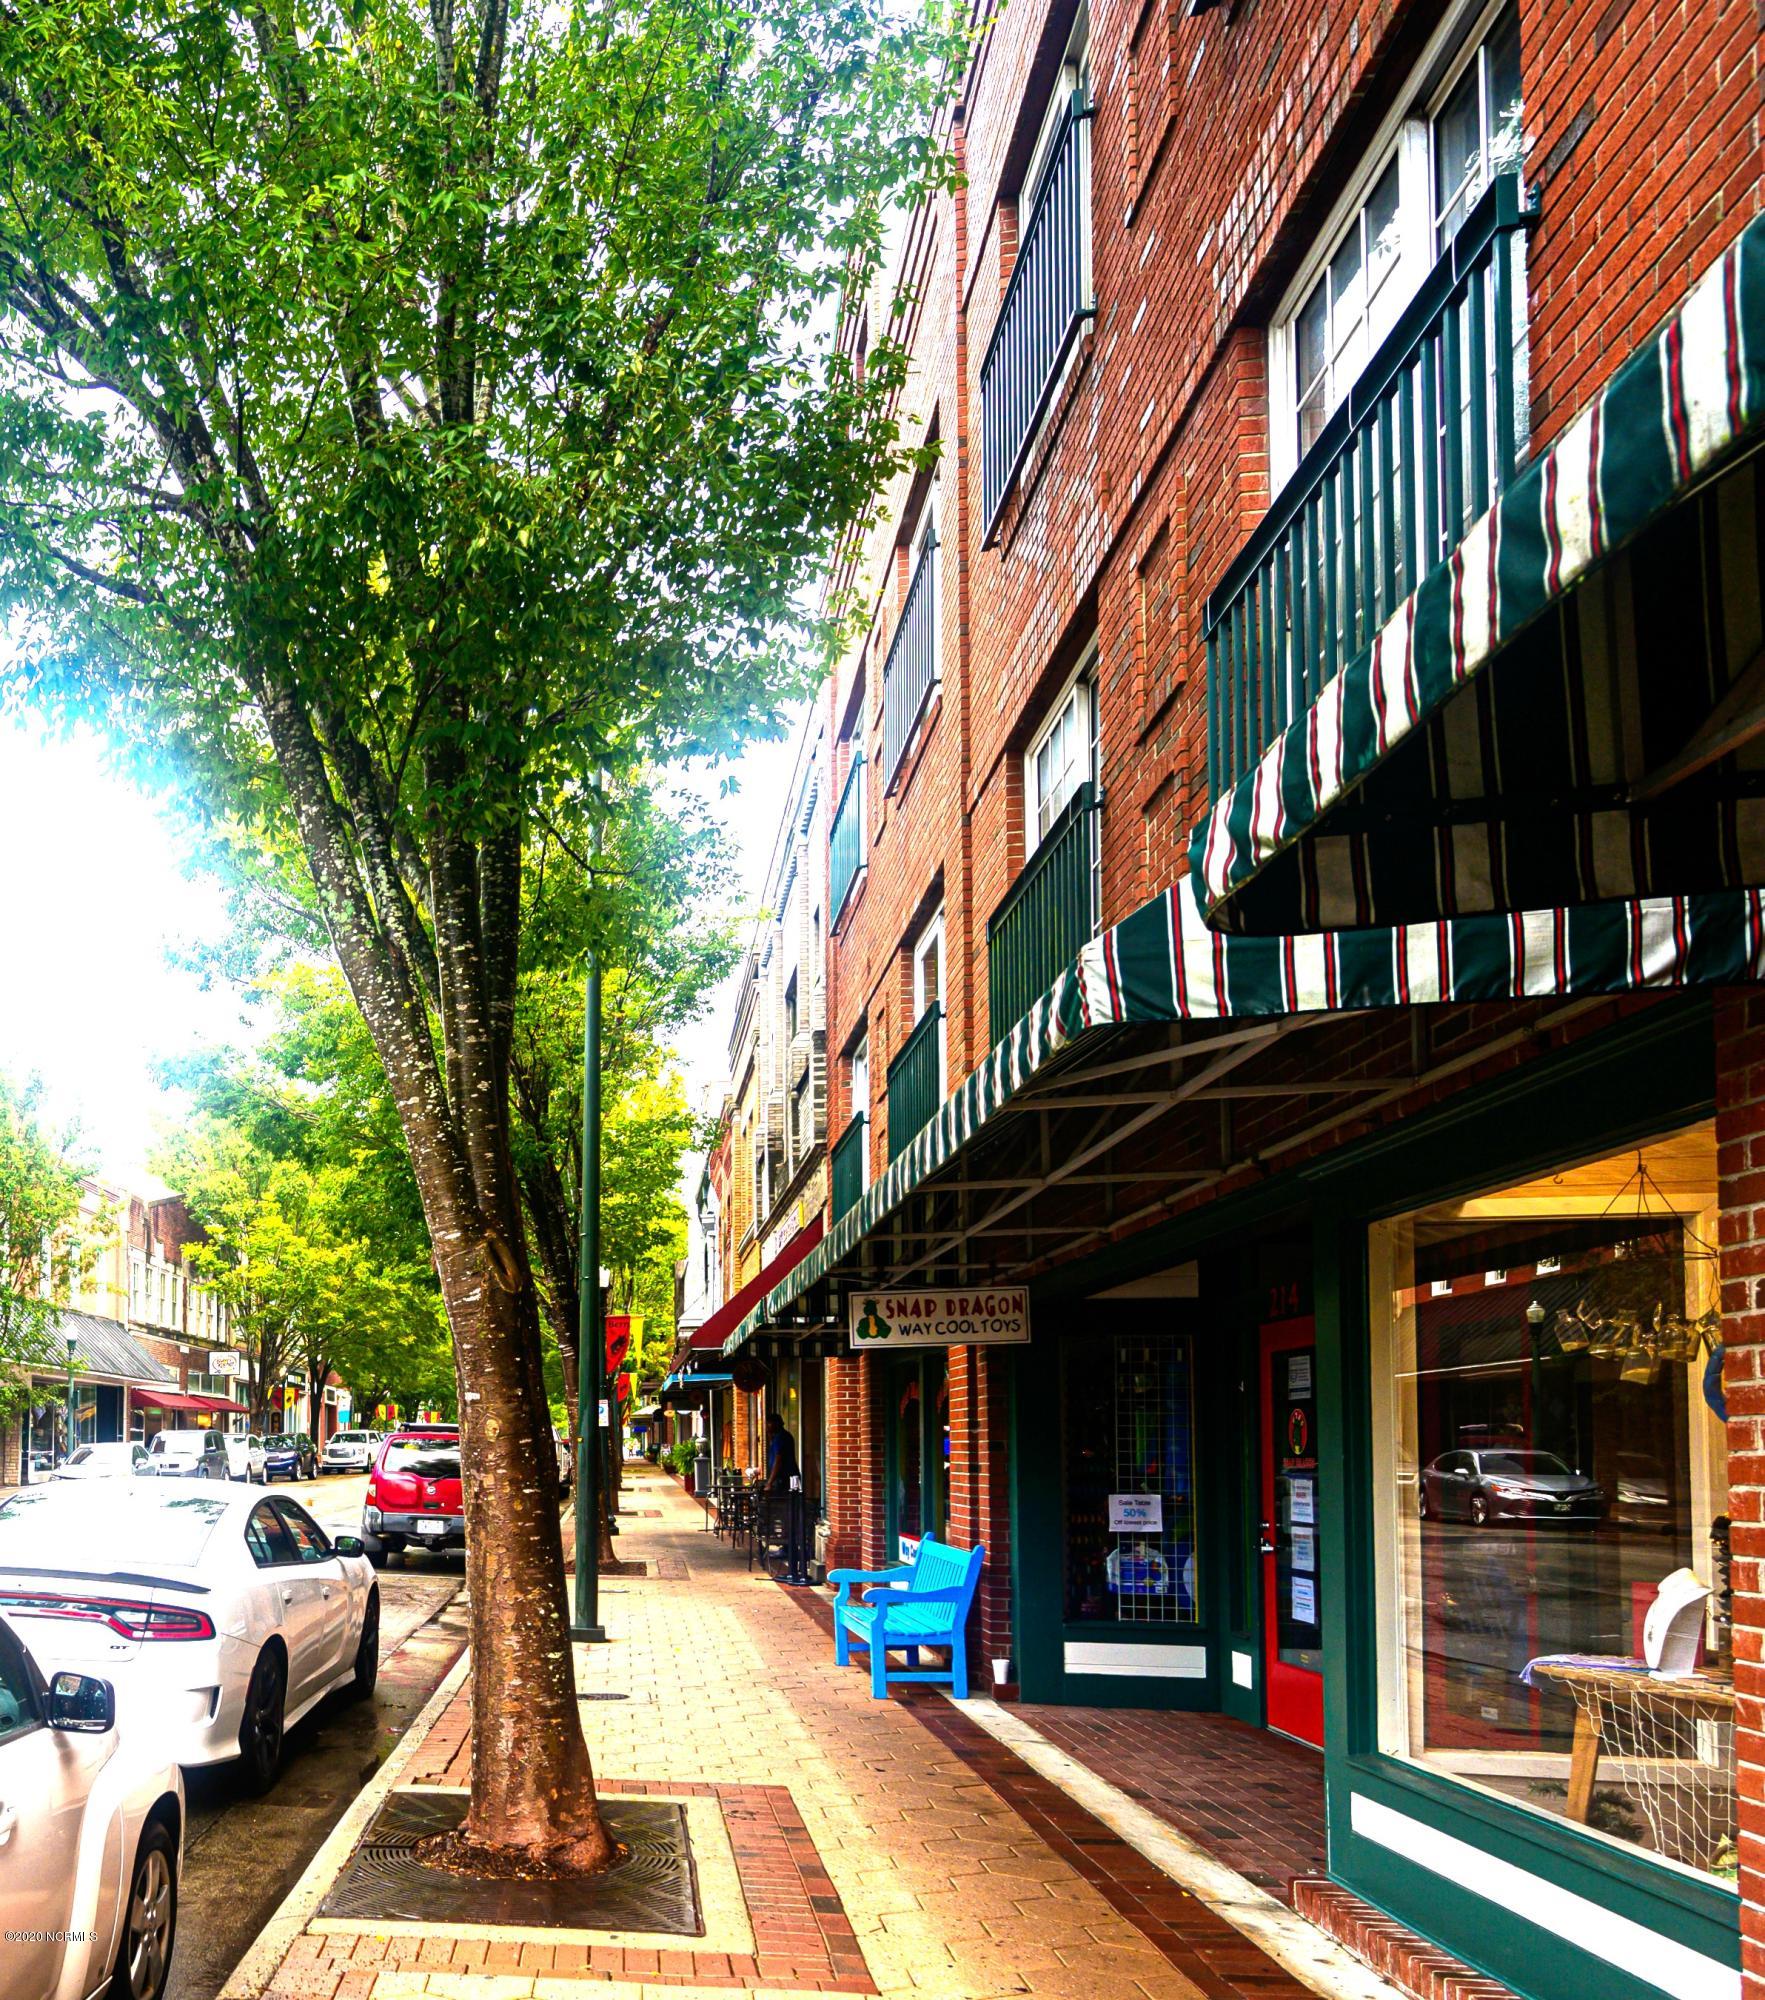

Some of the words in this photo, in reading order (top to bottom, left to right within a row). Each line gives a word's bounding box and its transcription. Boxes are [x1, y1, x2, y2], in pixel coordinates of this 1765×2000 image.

[886, 1297, 937, 1319] SNAP
[946, 1293, 1024, 1318] DRAGON
[898, 1322, 932, 1336] WAY
[935, 1319, 978, 1335] COOL
[983, 1319, 1021, 1333] TOYS
[1123, 1508, 1147, 1518] 50%
